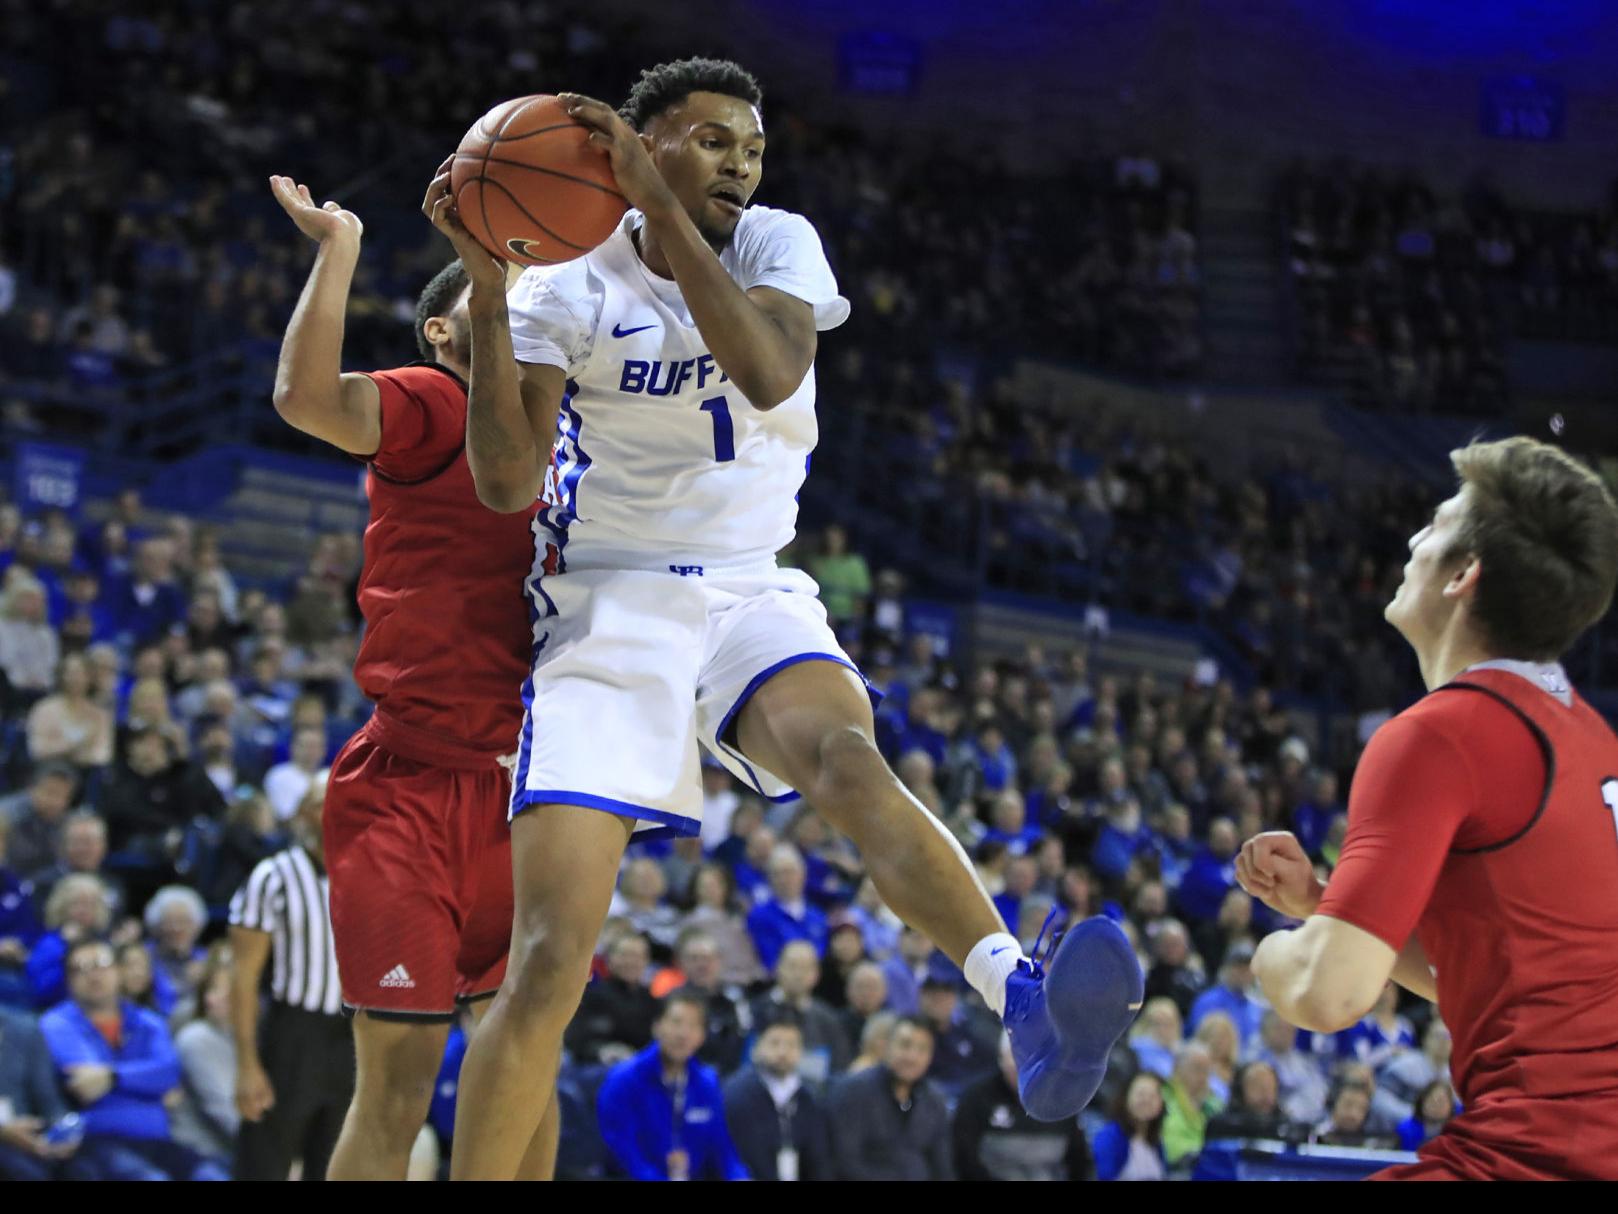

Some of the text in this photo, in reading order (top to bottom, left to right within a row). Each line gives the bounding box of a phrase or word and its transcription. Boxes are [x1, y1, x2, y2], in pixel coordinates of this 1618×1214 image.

[619, 353, 729, 396] BUFF
[700, 395, 735, 462] 1
[379, 979, 416, 989] adidas
